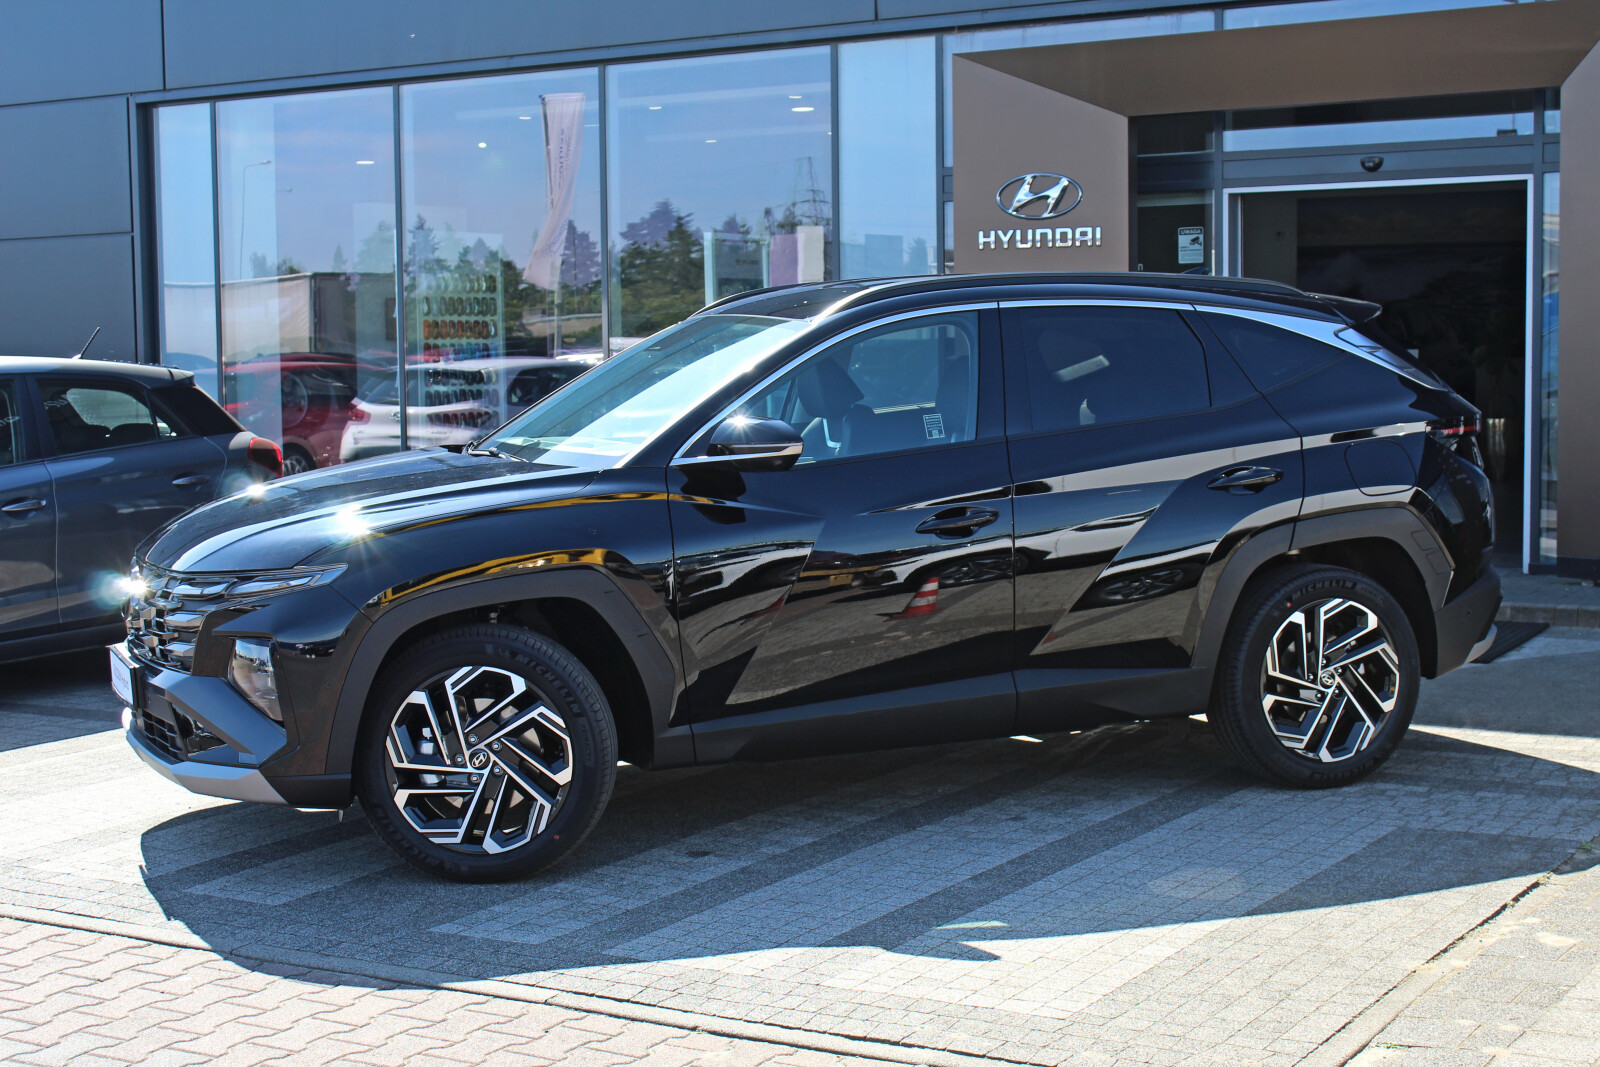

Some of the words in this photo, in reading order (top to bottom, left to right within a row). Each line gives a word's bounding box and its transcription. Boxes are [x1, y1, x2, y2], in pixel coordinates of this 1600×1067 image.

[978, 226, 1102, 250] HYUNDAI
[1291, 580, 1354, 601] MICHELIN
[516, 654, 583, 714] MICHELIN
